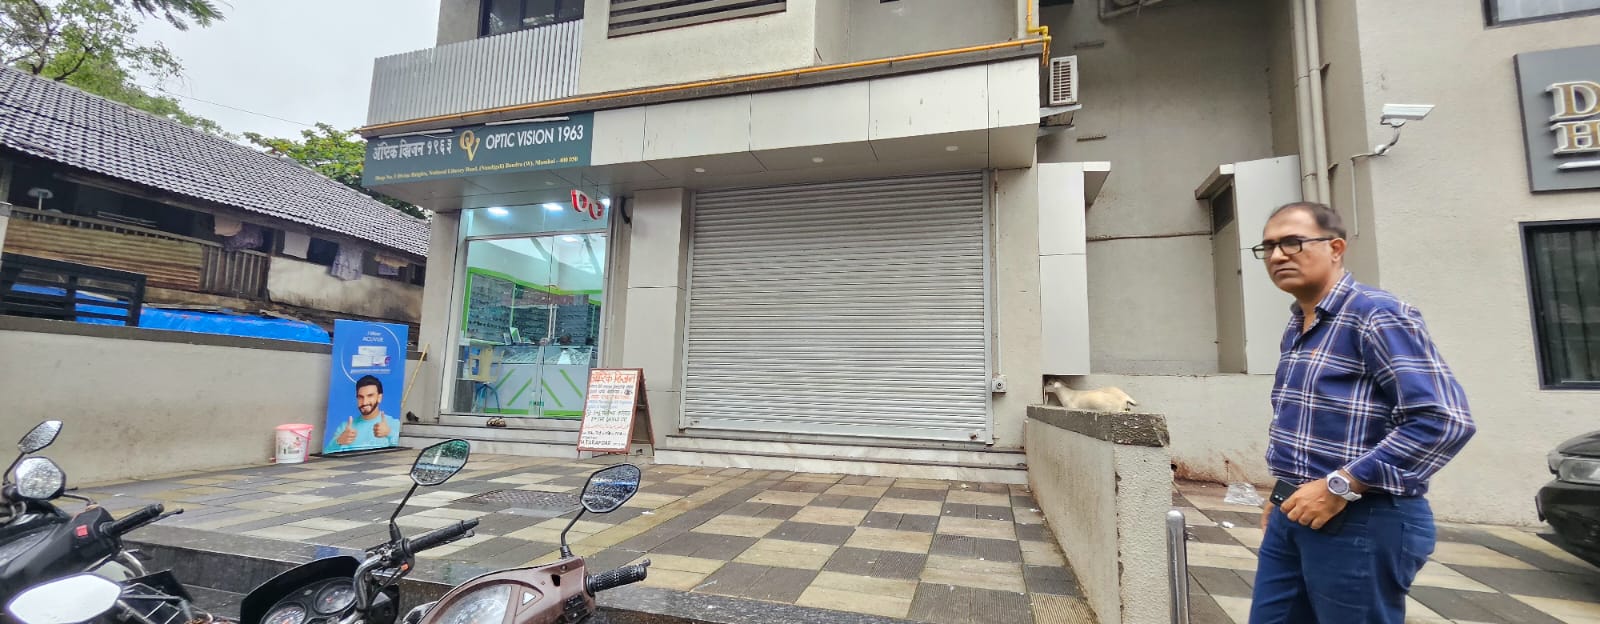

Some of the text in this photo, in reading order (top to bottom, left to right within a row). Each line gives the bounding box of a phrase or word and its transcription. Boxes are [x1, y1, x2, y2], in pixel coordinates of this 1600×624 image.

[428, 139, 452, 155] १९६३
[486, 125, 583, 149] OPTIC VISION 1963
